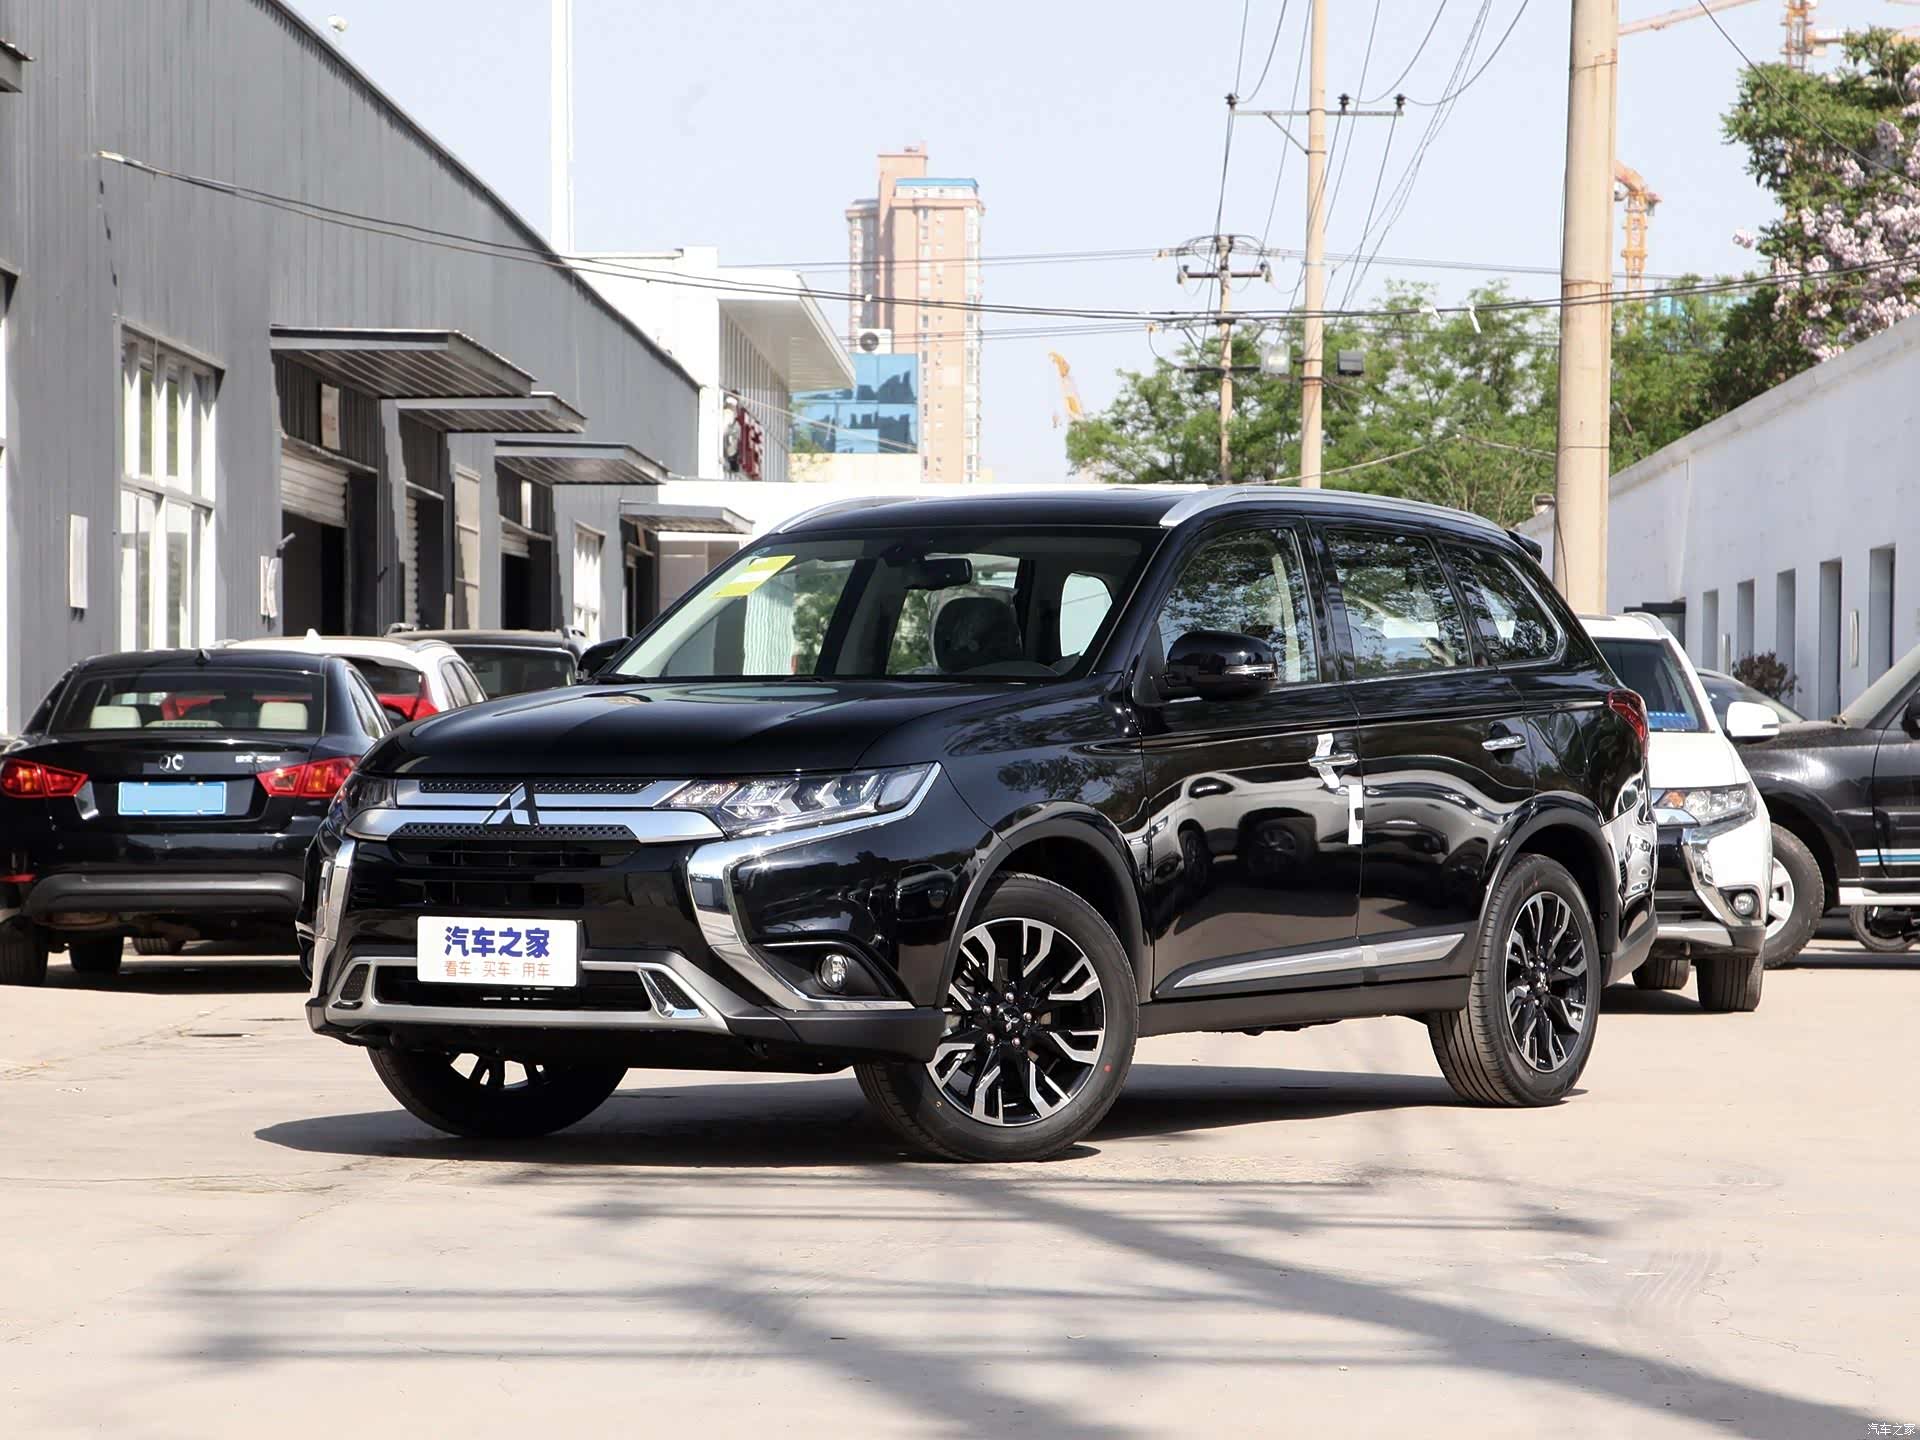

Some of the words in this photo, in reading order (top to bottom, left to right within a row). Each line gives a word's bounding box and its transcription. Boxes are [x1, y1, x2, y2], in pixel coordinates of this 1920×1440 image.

[444, 926, 550, 958] 汽车之家
[444, 960, 472, 977] 看车
[482, 961, 511, 977] 买车
[522, 962, 552, 979] 用车
